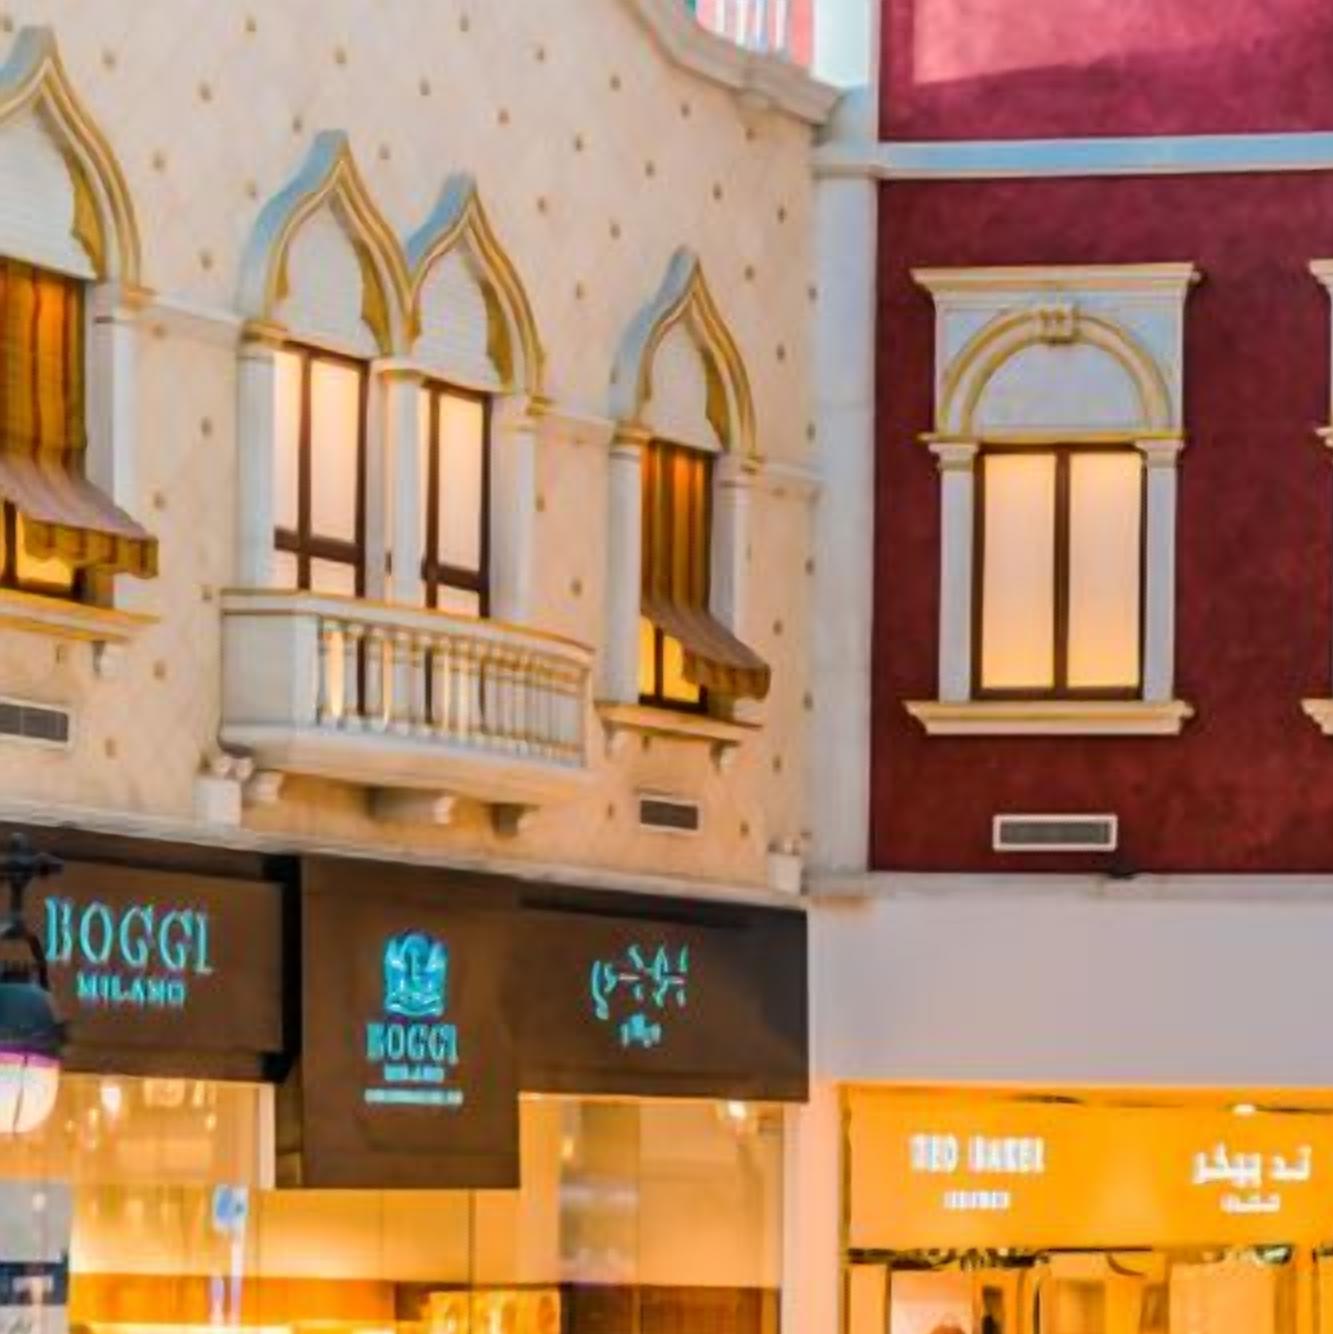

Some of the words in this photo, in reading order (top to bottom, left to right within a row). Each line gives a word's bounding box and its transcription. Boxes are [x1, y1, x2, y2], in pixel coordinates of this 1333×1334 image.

[44, 895, 213, 974] BOGGI
[76, 969, 187, 1006] MILANO
[366, 1022, 459, 1065] BOGGI
